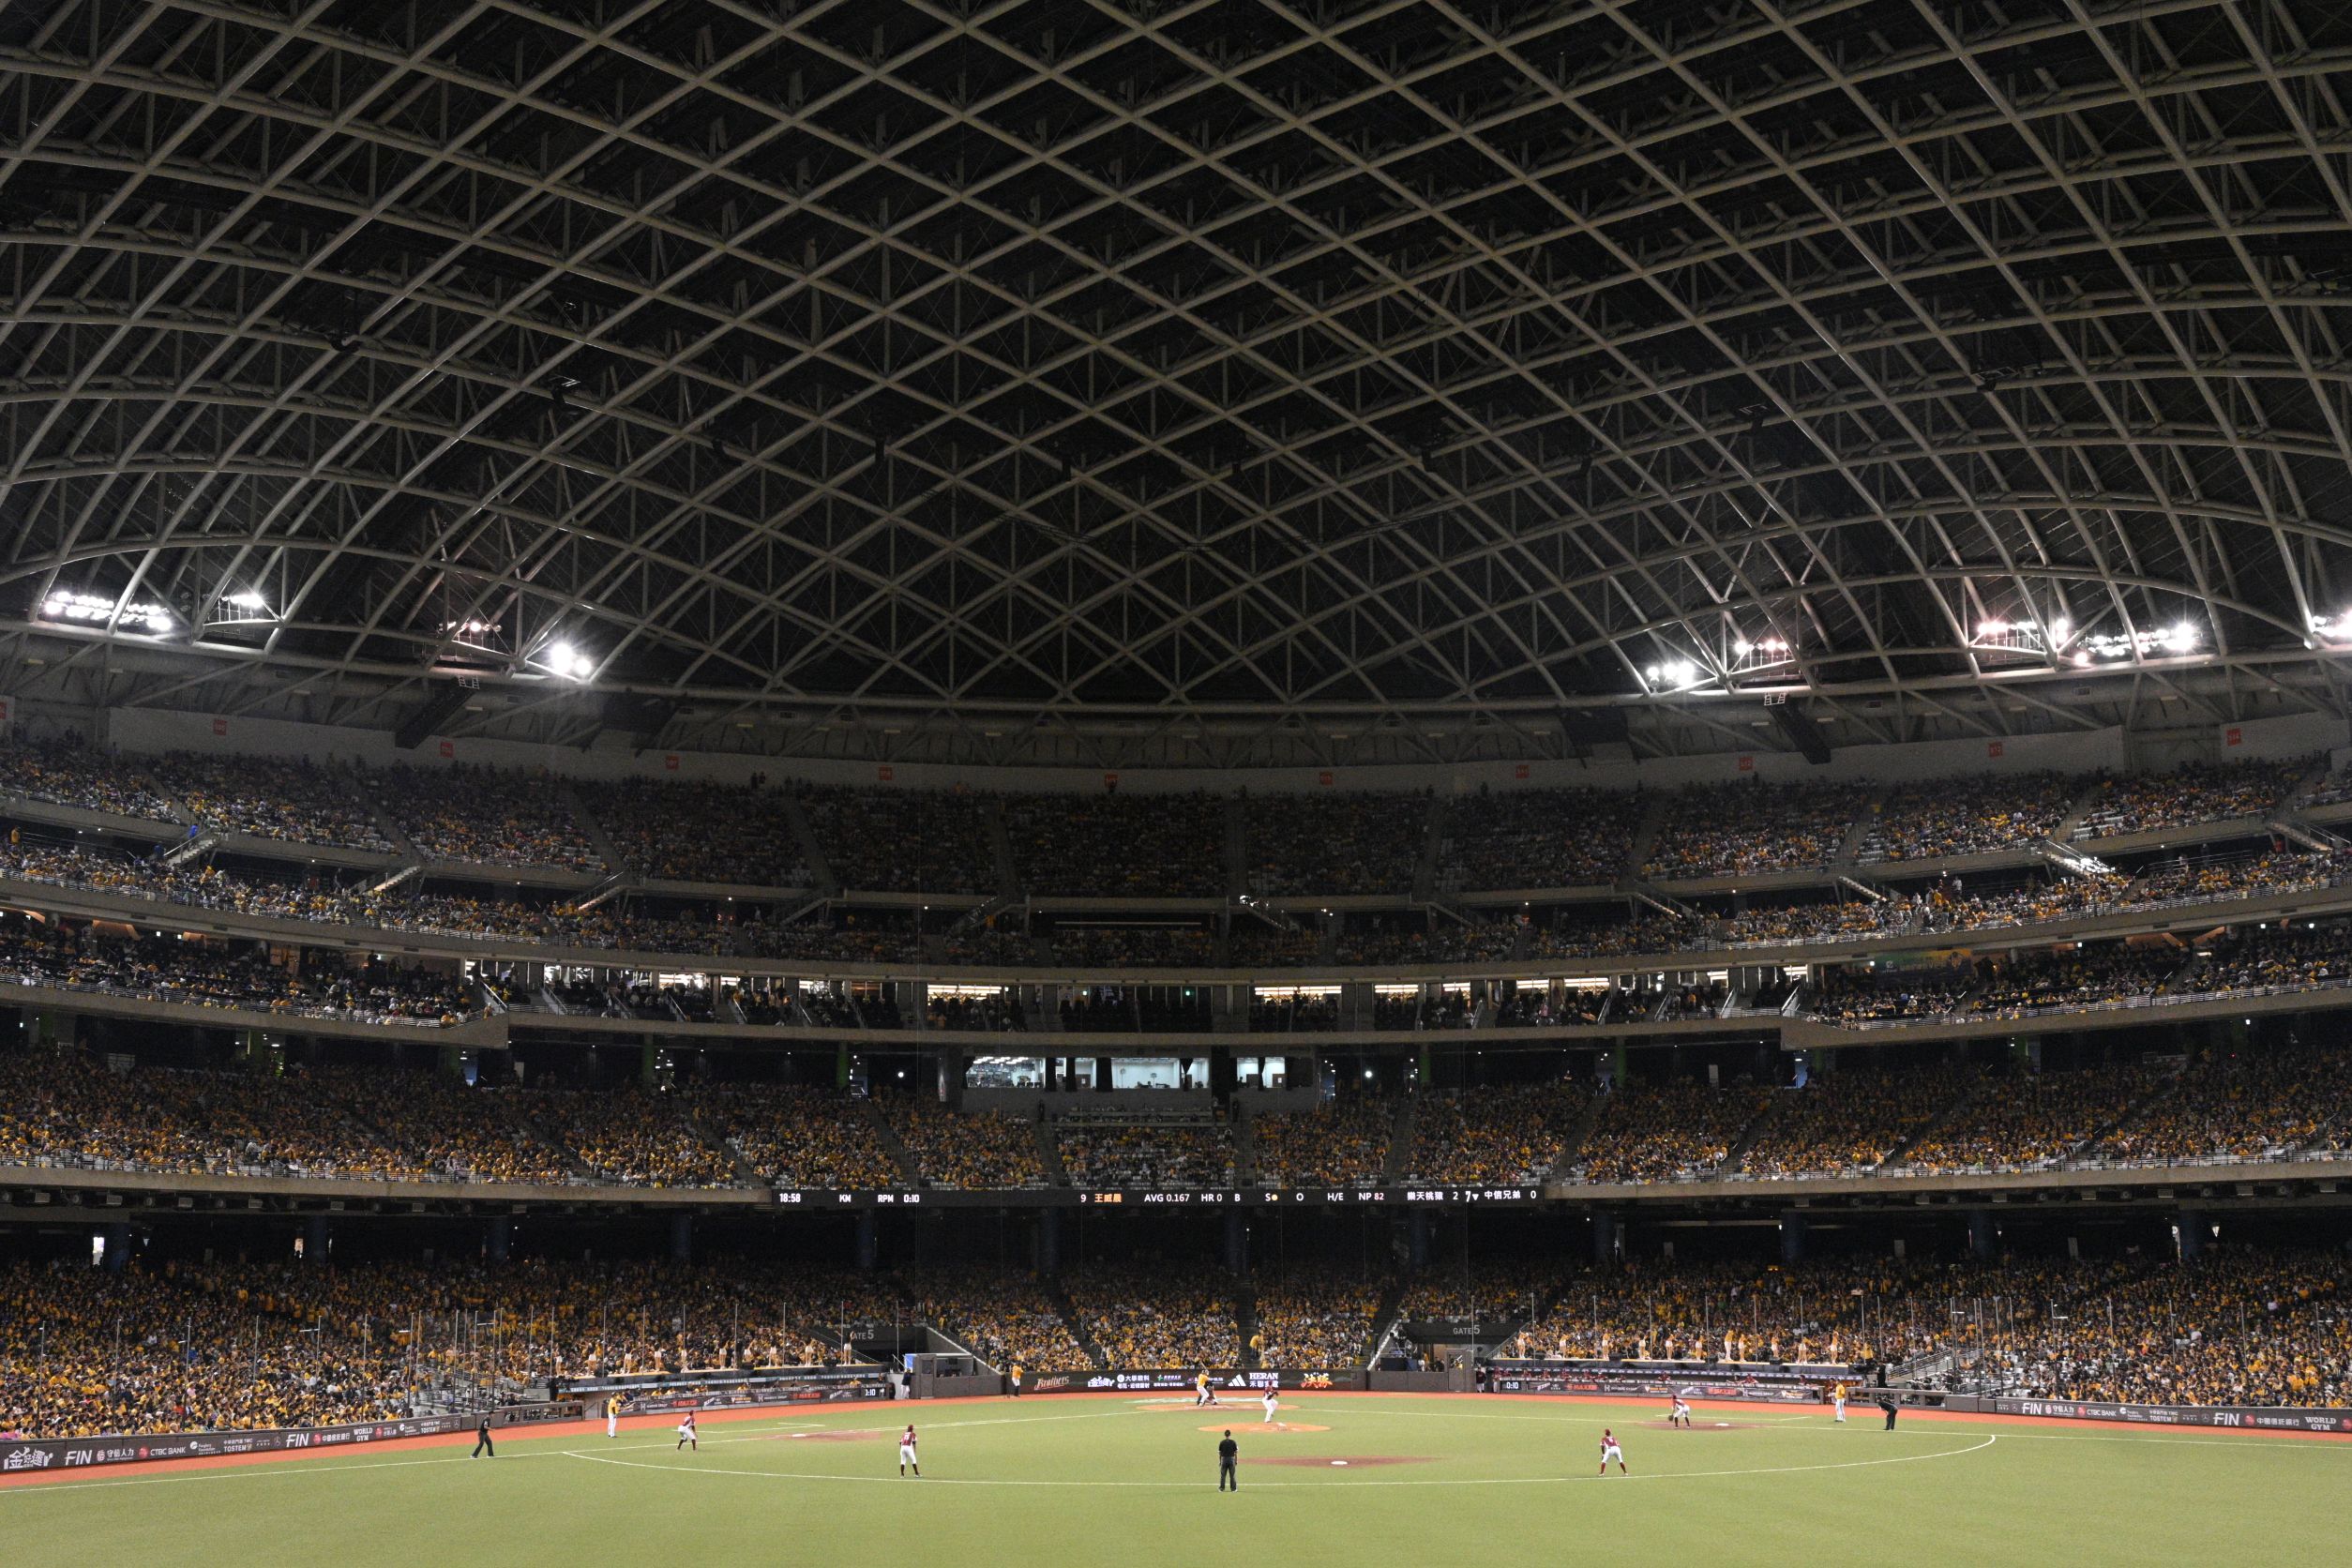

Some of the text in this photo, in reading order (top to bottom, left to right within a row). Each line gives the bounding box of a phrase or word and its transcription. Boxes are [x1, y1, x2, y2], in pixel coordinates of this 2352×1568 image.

[779, 1193, 801, 1203] 18:58
[839, 1194, 852, 1203] KM
[878, 1194, 920, 1203] RPM 0:10
[1080, 1194, 1122, 1203] 9 王威晨
[1144, 1194, 1190, 1202] AVG 0.167
[1201, 1194, 1223, 1202] HR 0
[1234, 1194, 1241, 1202] B
[1265, 1193, 1271, 1201] S
[1327, 1193, 1344, 1202] H/E
[1358, 1193, 1384, 1201] NP 82
[1407, 1191, 1458, 1201] 樂天桃猿 2
[1465, 1191, 1471, 1202] 7
[1485, 1190, 1537, 1200] 中信兄弟 0
[1453, 1324, 1481, 1335] GATE 5
[867, 1329, 874, 1340] 5
[1033, 1375, 1070, 1391] Brothers
[2022, 1402, 2042, 1415] FIN
[2213, 1412, 2240, 1426] FIN
[2304, 1416, 2336, 1425] WORLD
[354, 1427, 373, 1436] WORLD
[285, 1433, 309, 1448] FIN
[224, 1444, 247, 1453] TOSTEM
[64, 1450, 92, 1466] FIN
